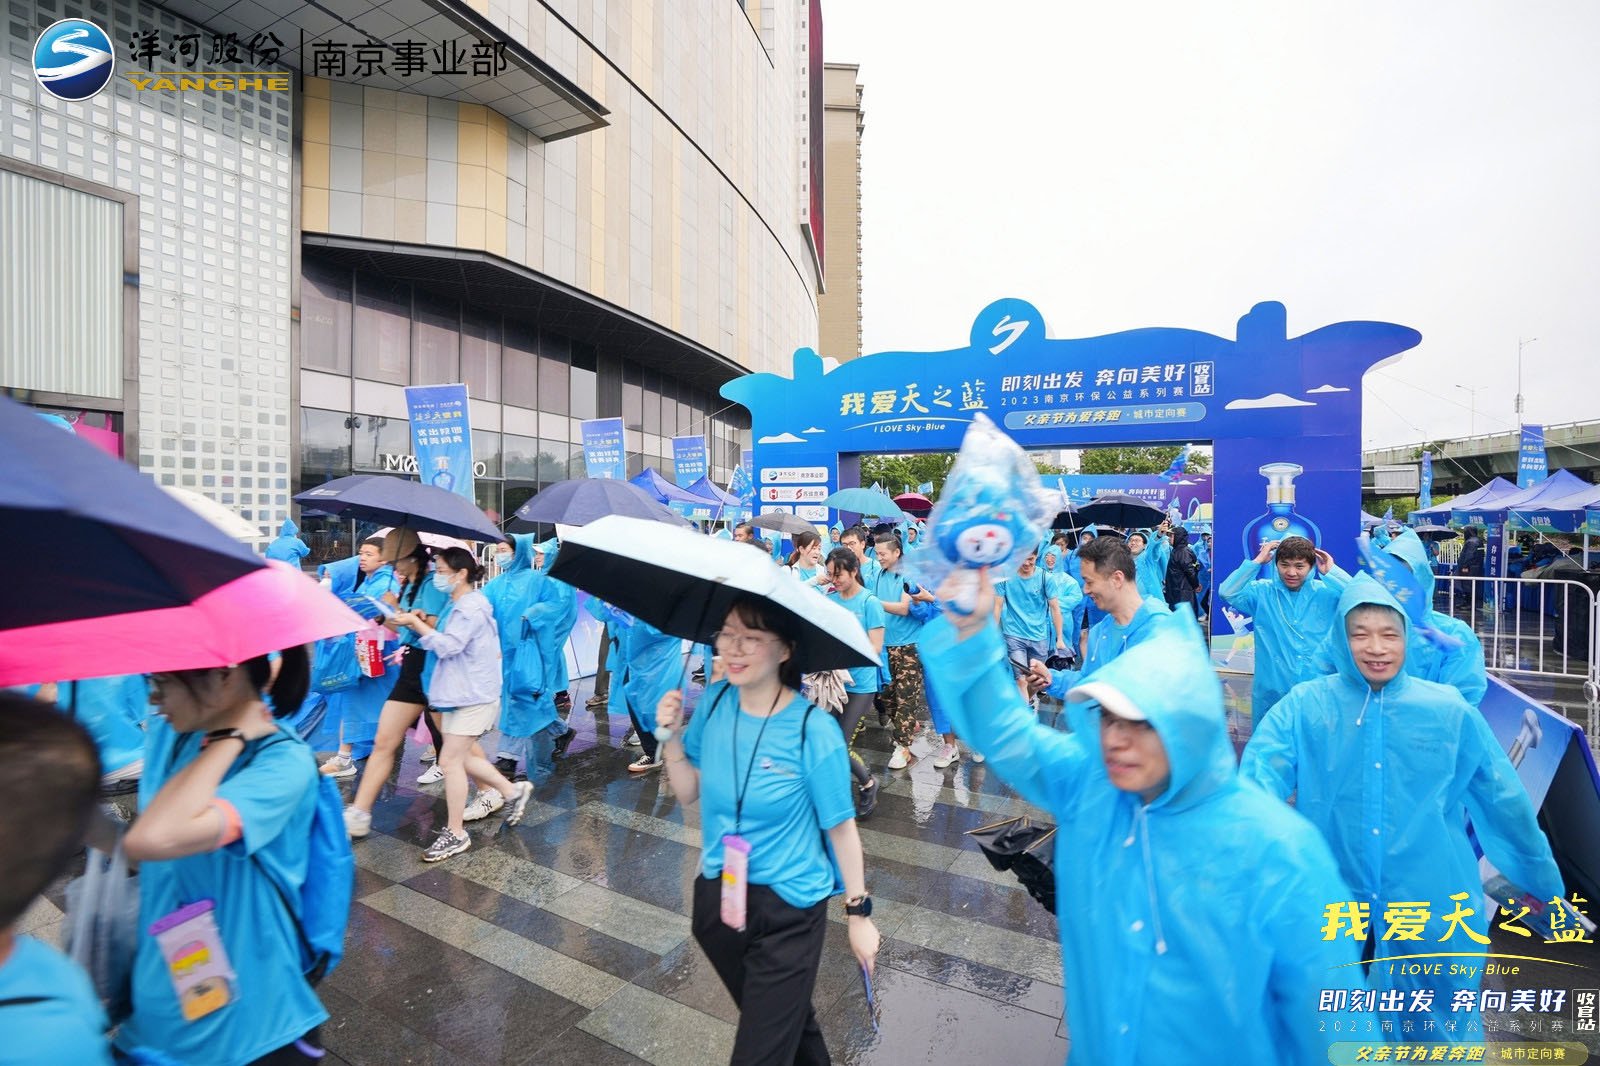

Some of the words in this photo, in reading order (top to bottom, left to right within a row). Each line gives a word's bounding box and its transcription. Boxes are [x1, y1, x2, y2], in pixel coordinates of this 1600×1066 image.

[1001, 371, 1084, 392] 即刻出发
[1095, 364, 1186, 386] 奔向美好
[1193, 364, 1211, 395] 收官站
[1001, 386, 1184, 406] 2023南京环保公益系列赛
[880, 424, 903, 433] LOVE
[905, 423, 946, 434] Sky-Blue
